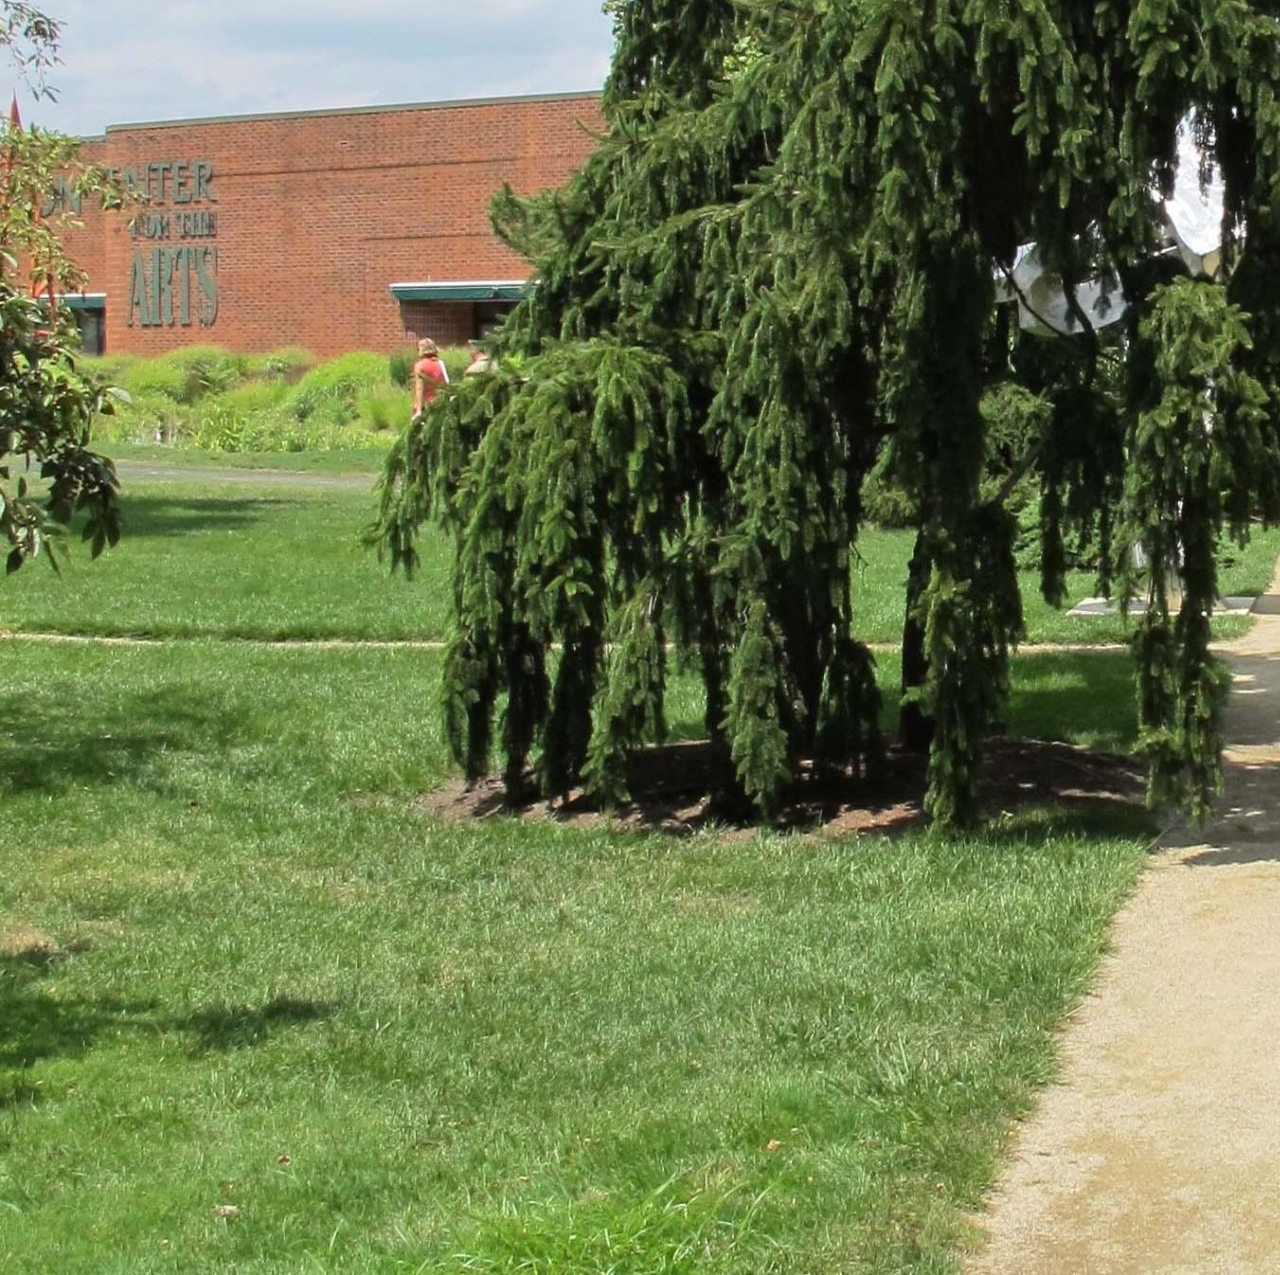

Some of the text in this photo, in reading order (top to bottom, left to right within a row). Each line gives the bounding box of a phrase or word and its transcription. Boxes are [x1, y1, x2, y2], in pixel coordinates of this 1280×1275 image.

[101, 160, 217, 205] ENTER
[177, 211, 217, 237] THE
[126, 246, 219, 327] ARTS
